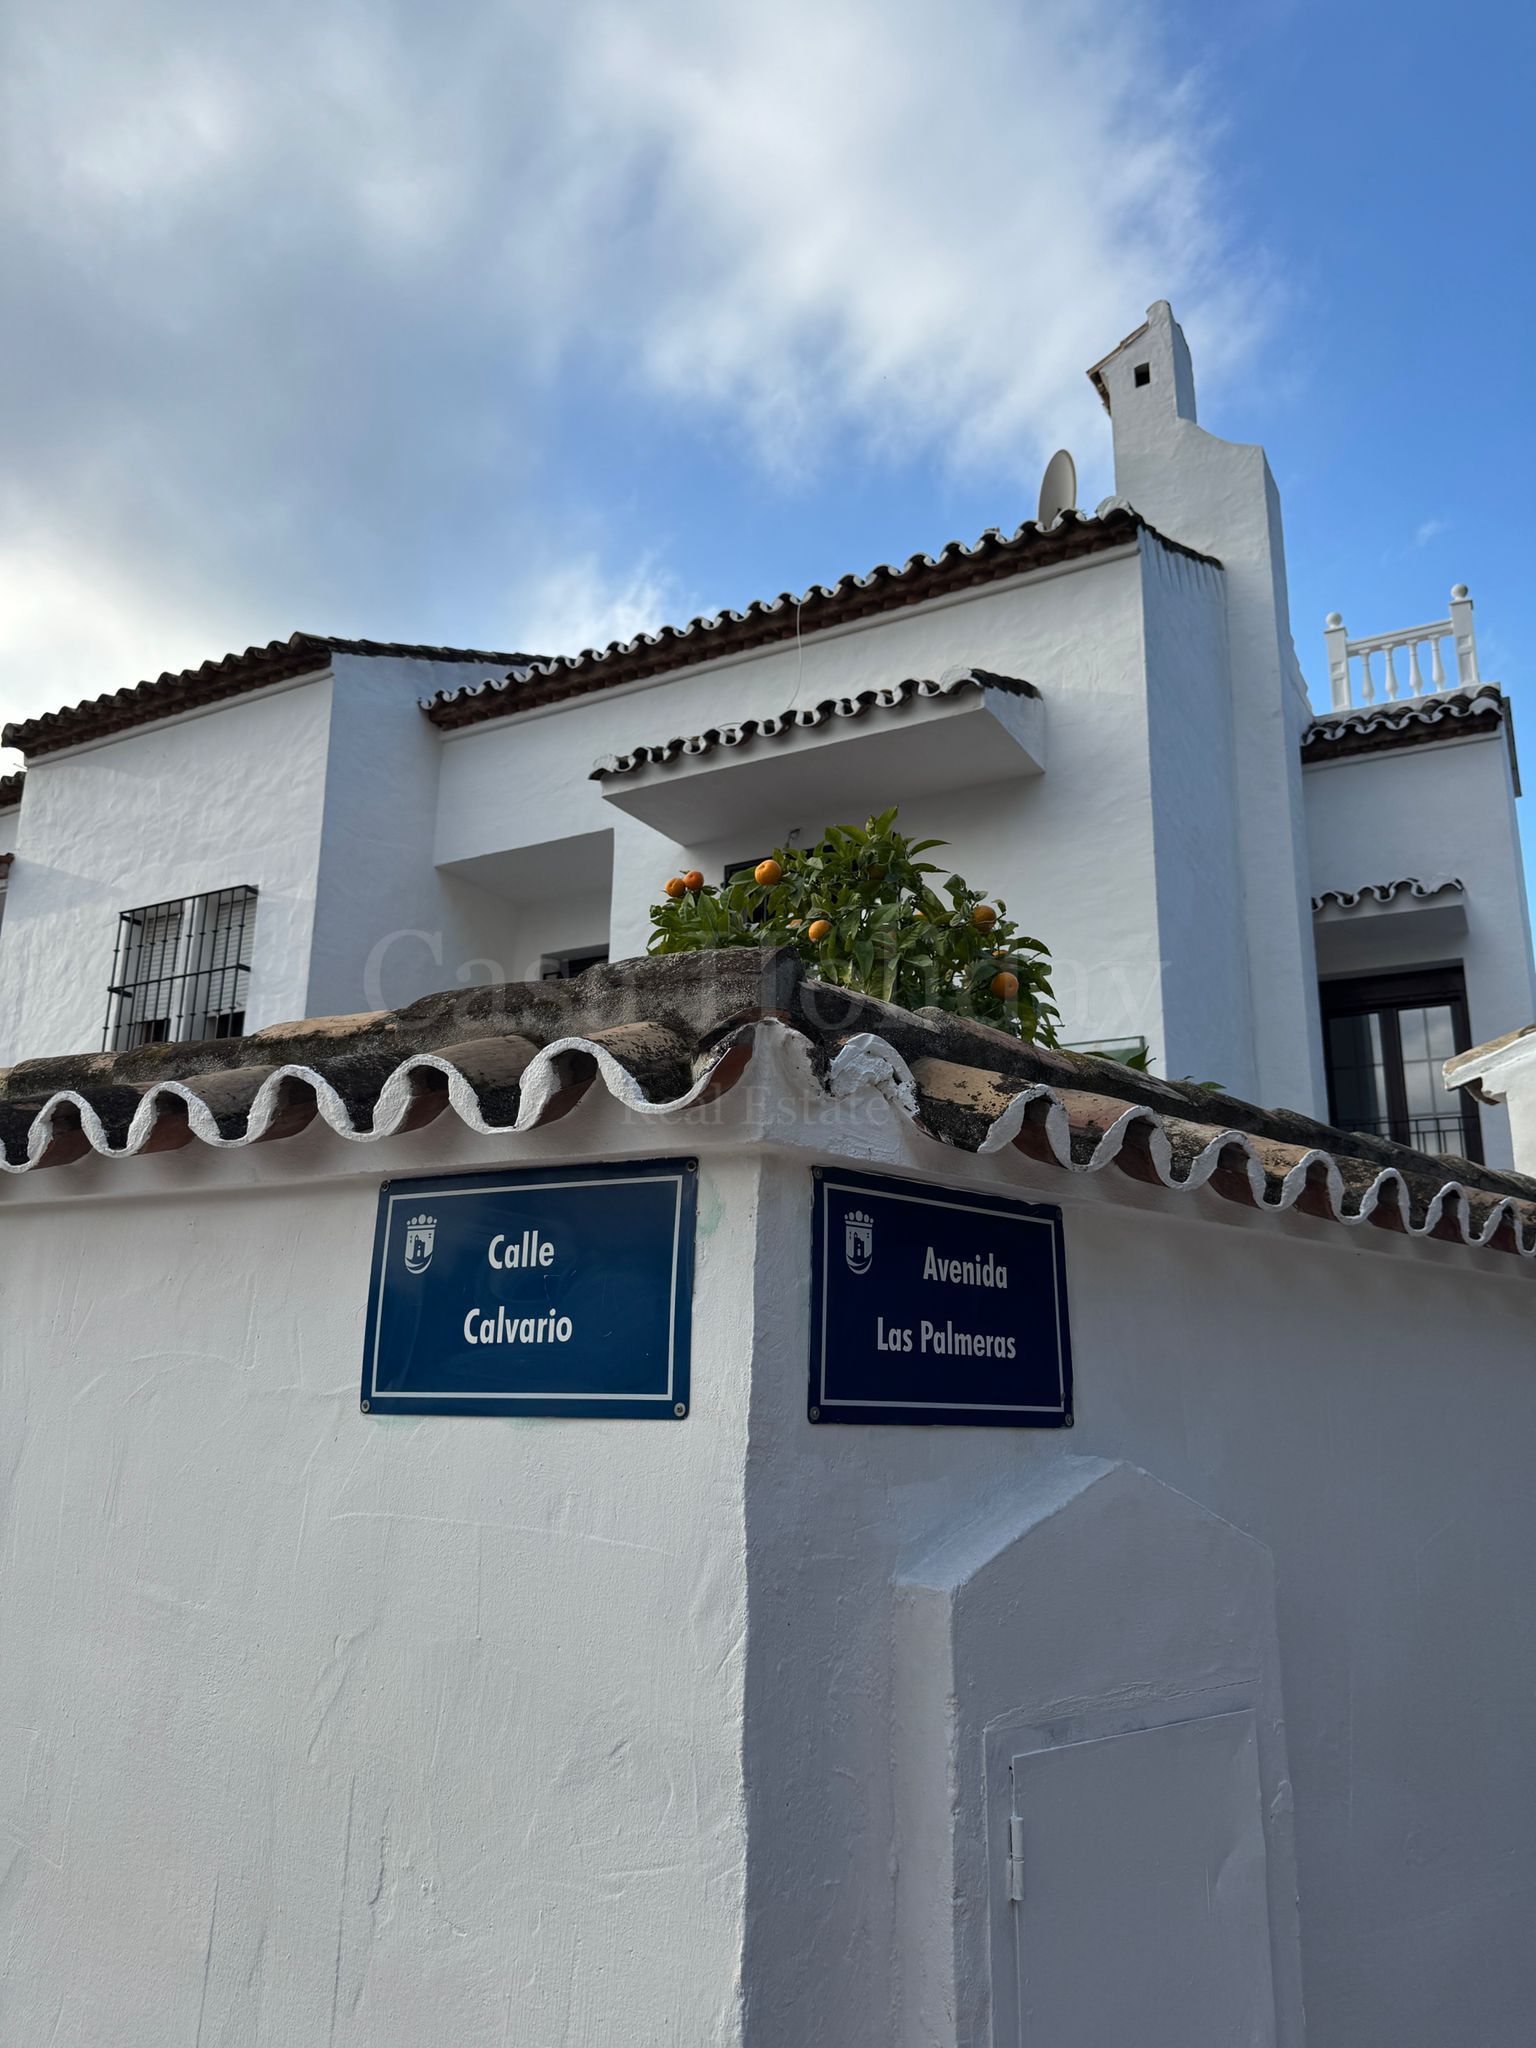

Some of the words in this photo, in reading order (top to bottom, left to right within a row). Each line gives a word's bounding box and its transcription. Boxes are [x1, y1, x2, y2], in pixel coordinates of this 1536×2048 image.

[488, 1230, 555, 1270] Calle
[923, 1246, 1008, 1289] Avenida
[463, 1306, 573, 1345] Calvario
[877, 1316, 912, 1352] Las
[920, 1320, 1017, 1360] Palmeras
